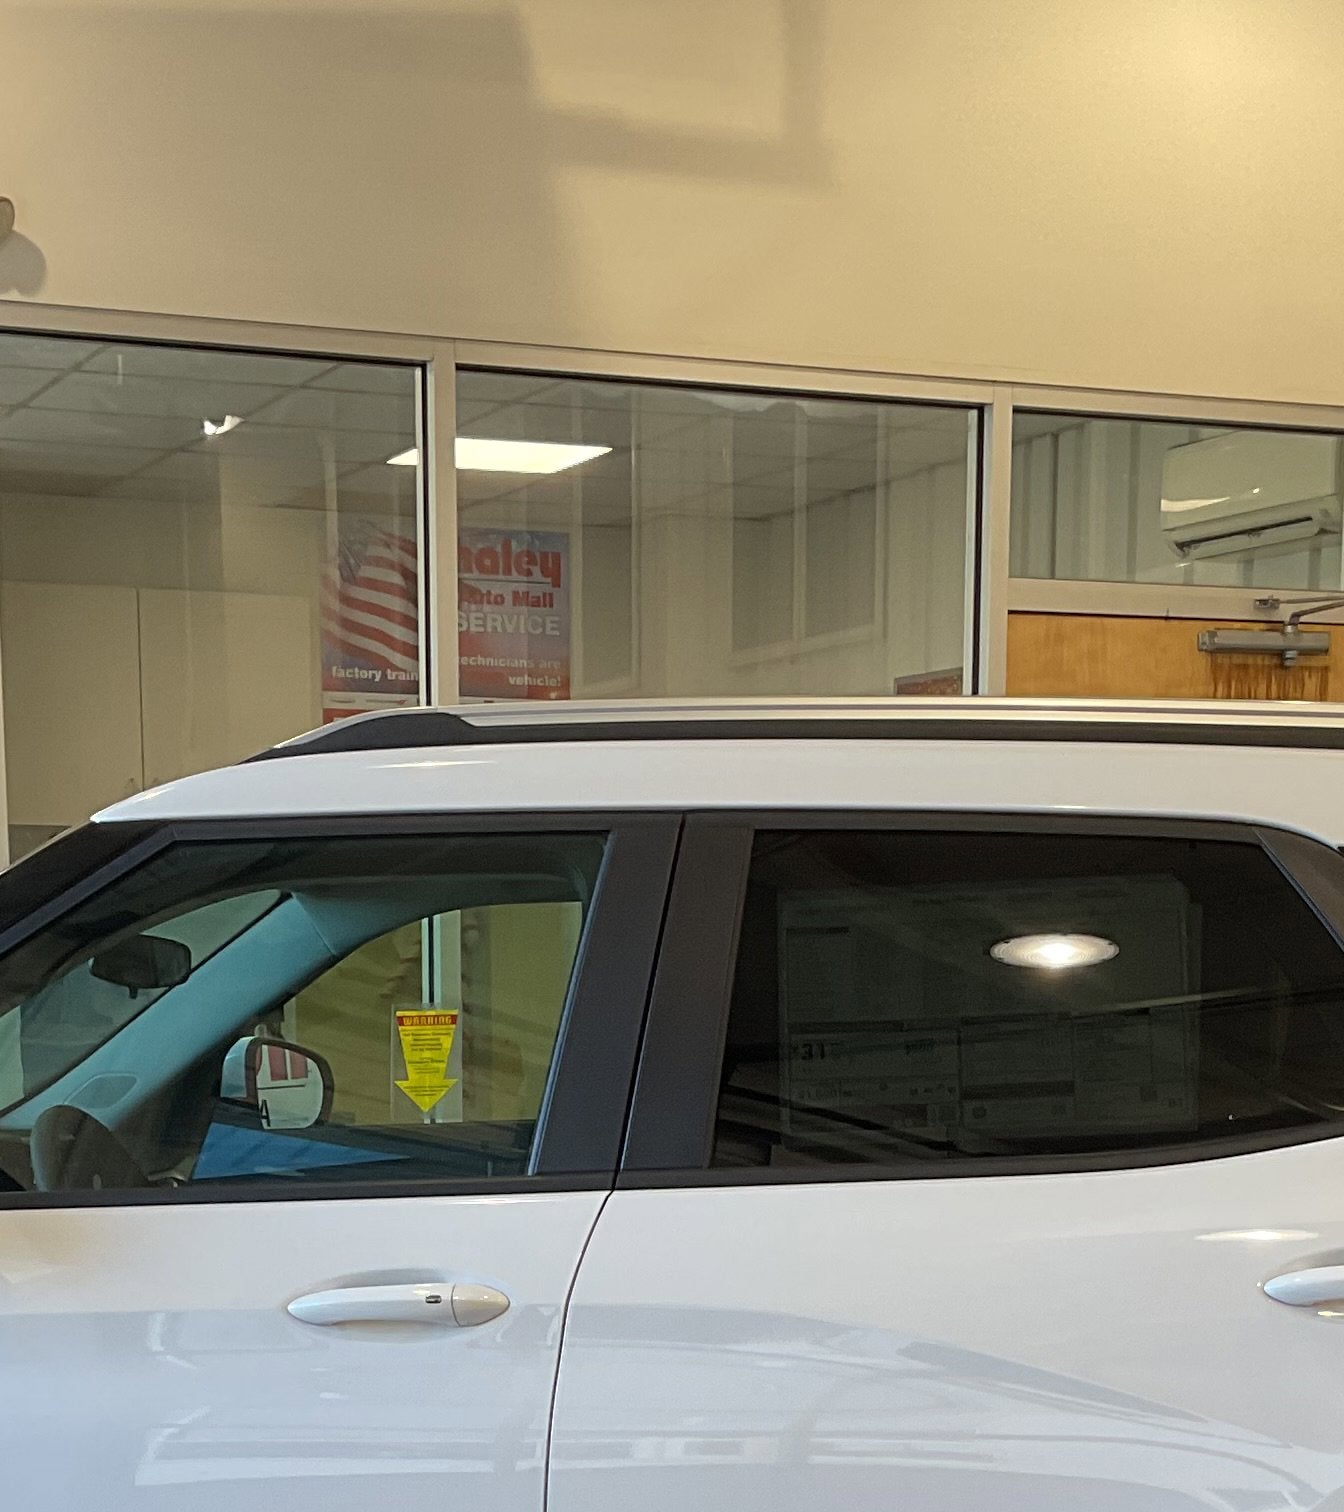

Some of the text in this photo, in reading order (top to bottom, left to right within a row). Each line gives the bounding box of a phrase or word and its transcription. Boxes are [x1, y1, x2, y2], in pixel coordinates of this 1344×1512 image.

[459, 589, 554, 608] uto Mall
[458, 611, 560, 636] SERVICE
[458, 655, 535, 669] echnicians
[332, 665, 382, 682] factory
[403, 1016, 453, 1026] WARNING
